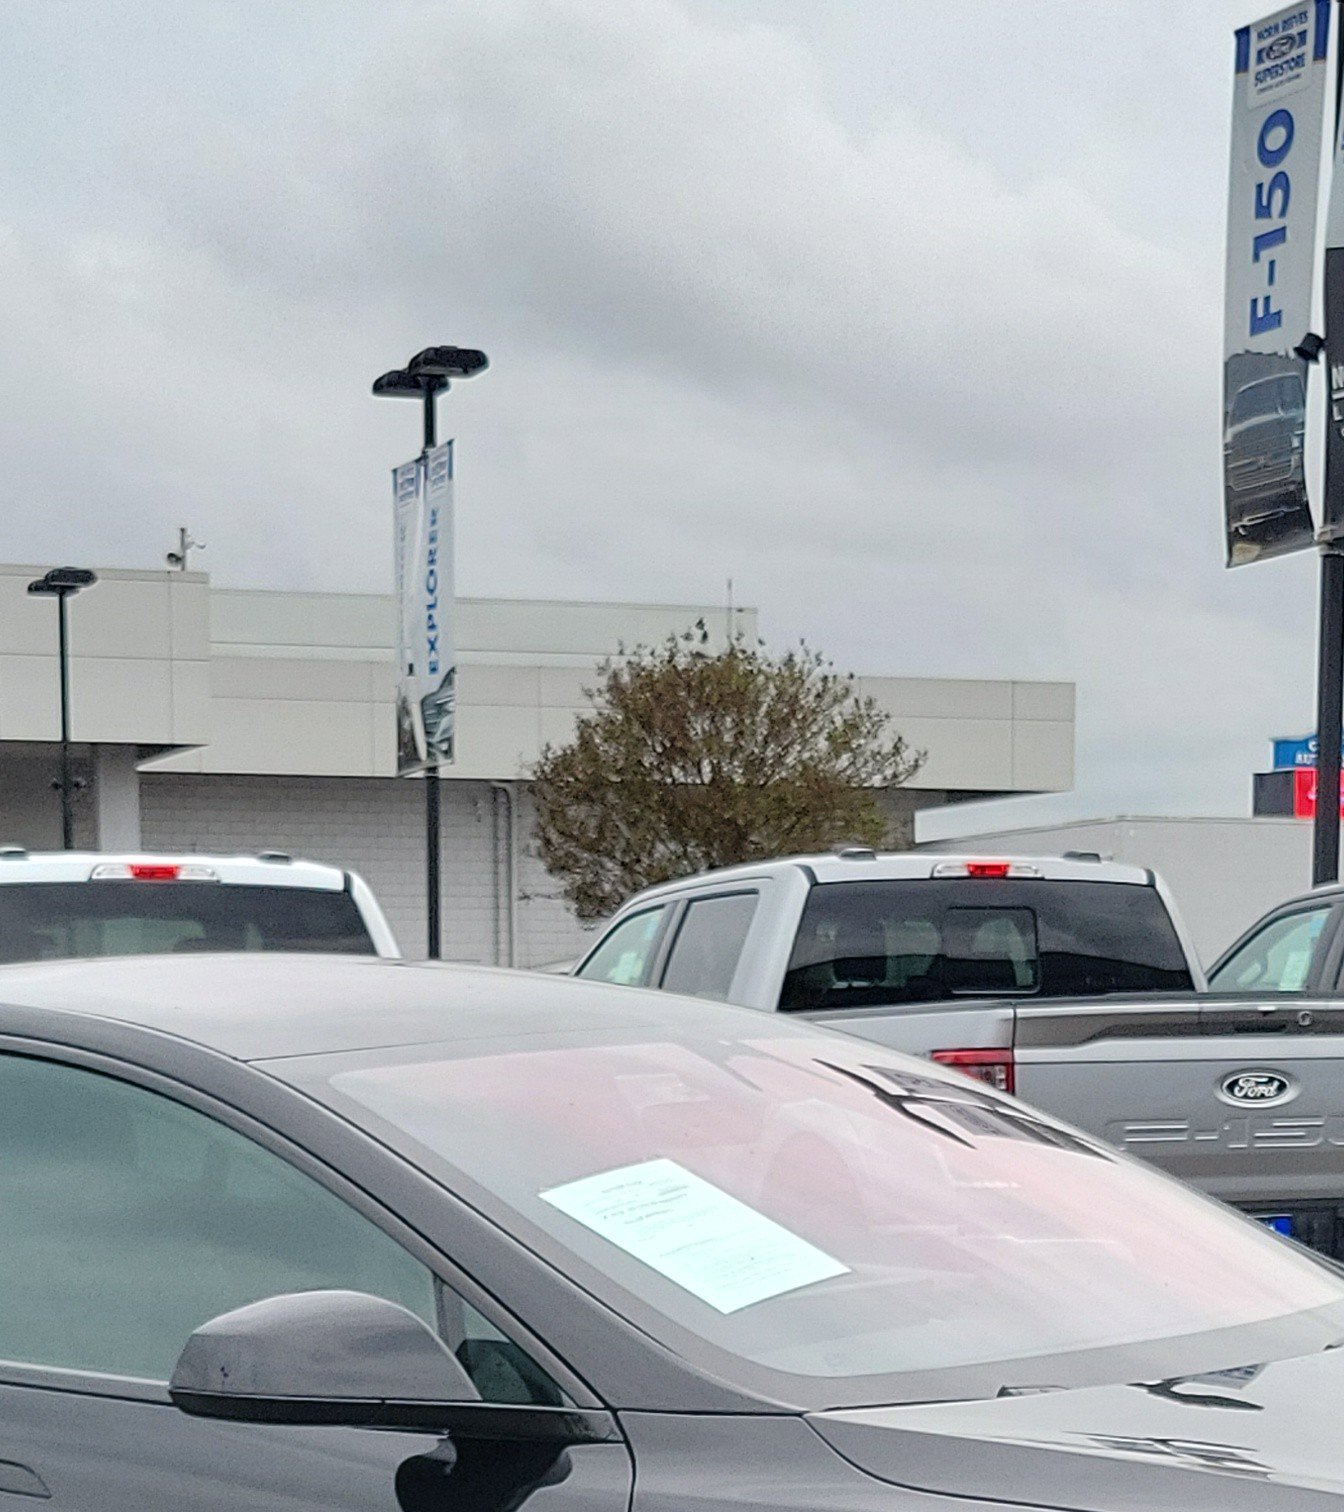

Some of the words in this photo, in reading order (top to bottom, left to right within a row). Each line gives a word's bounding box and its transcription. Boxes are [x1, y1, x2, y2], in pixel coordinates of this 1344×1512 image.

[1250, 108, 1296, 337] F-150
[425, 508, 439, 676] EXPLORER
[1234, 1076, 1280, 1099] Ford
